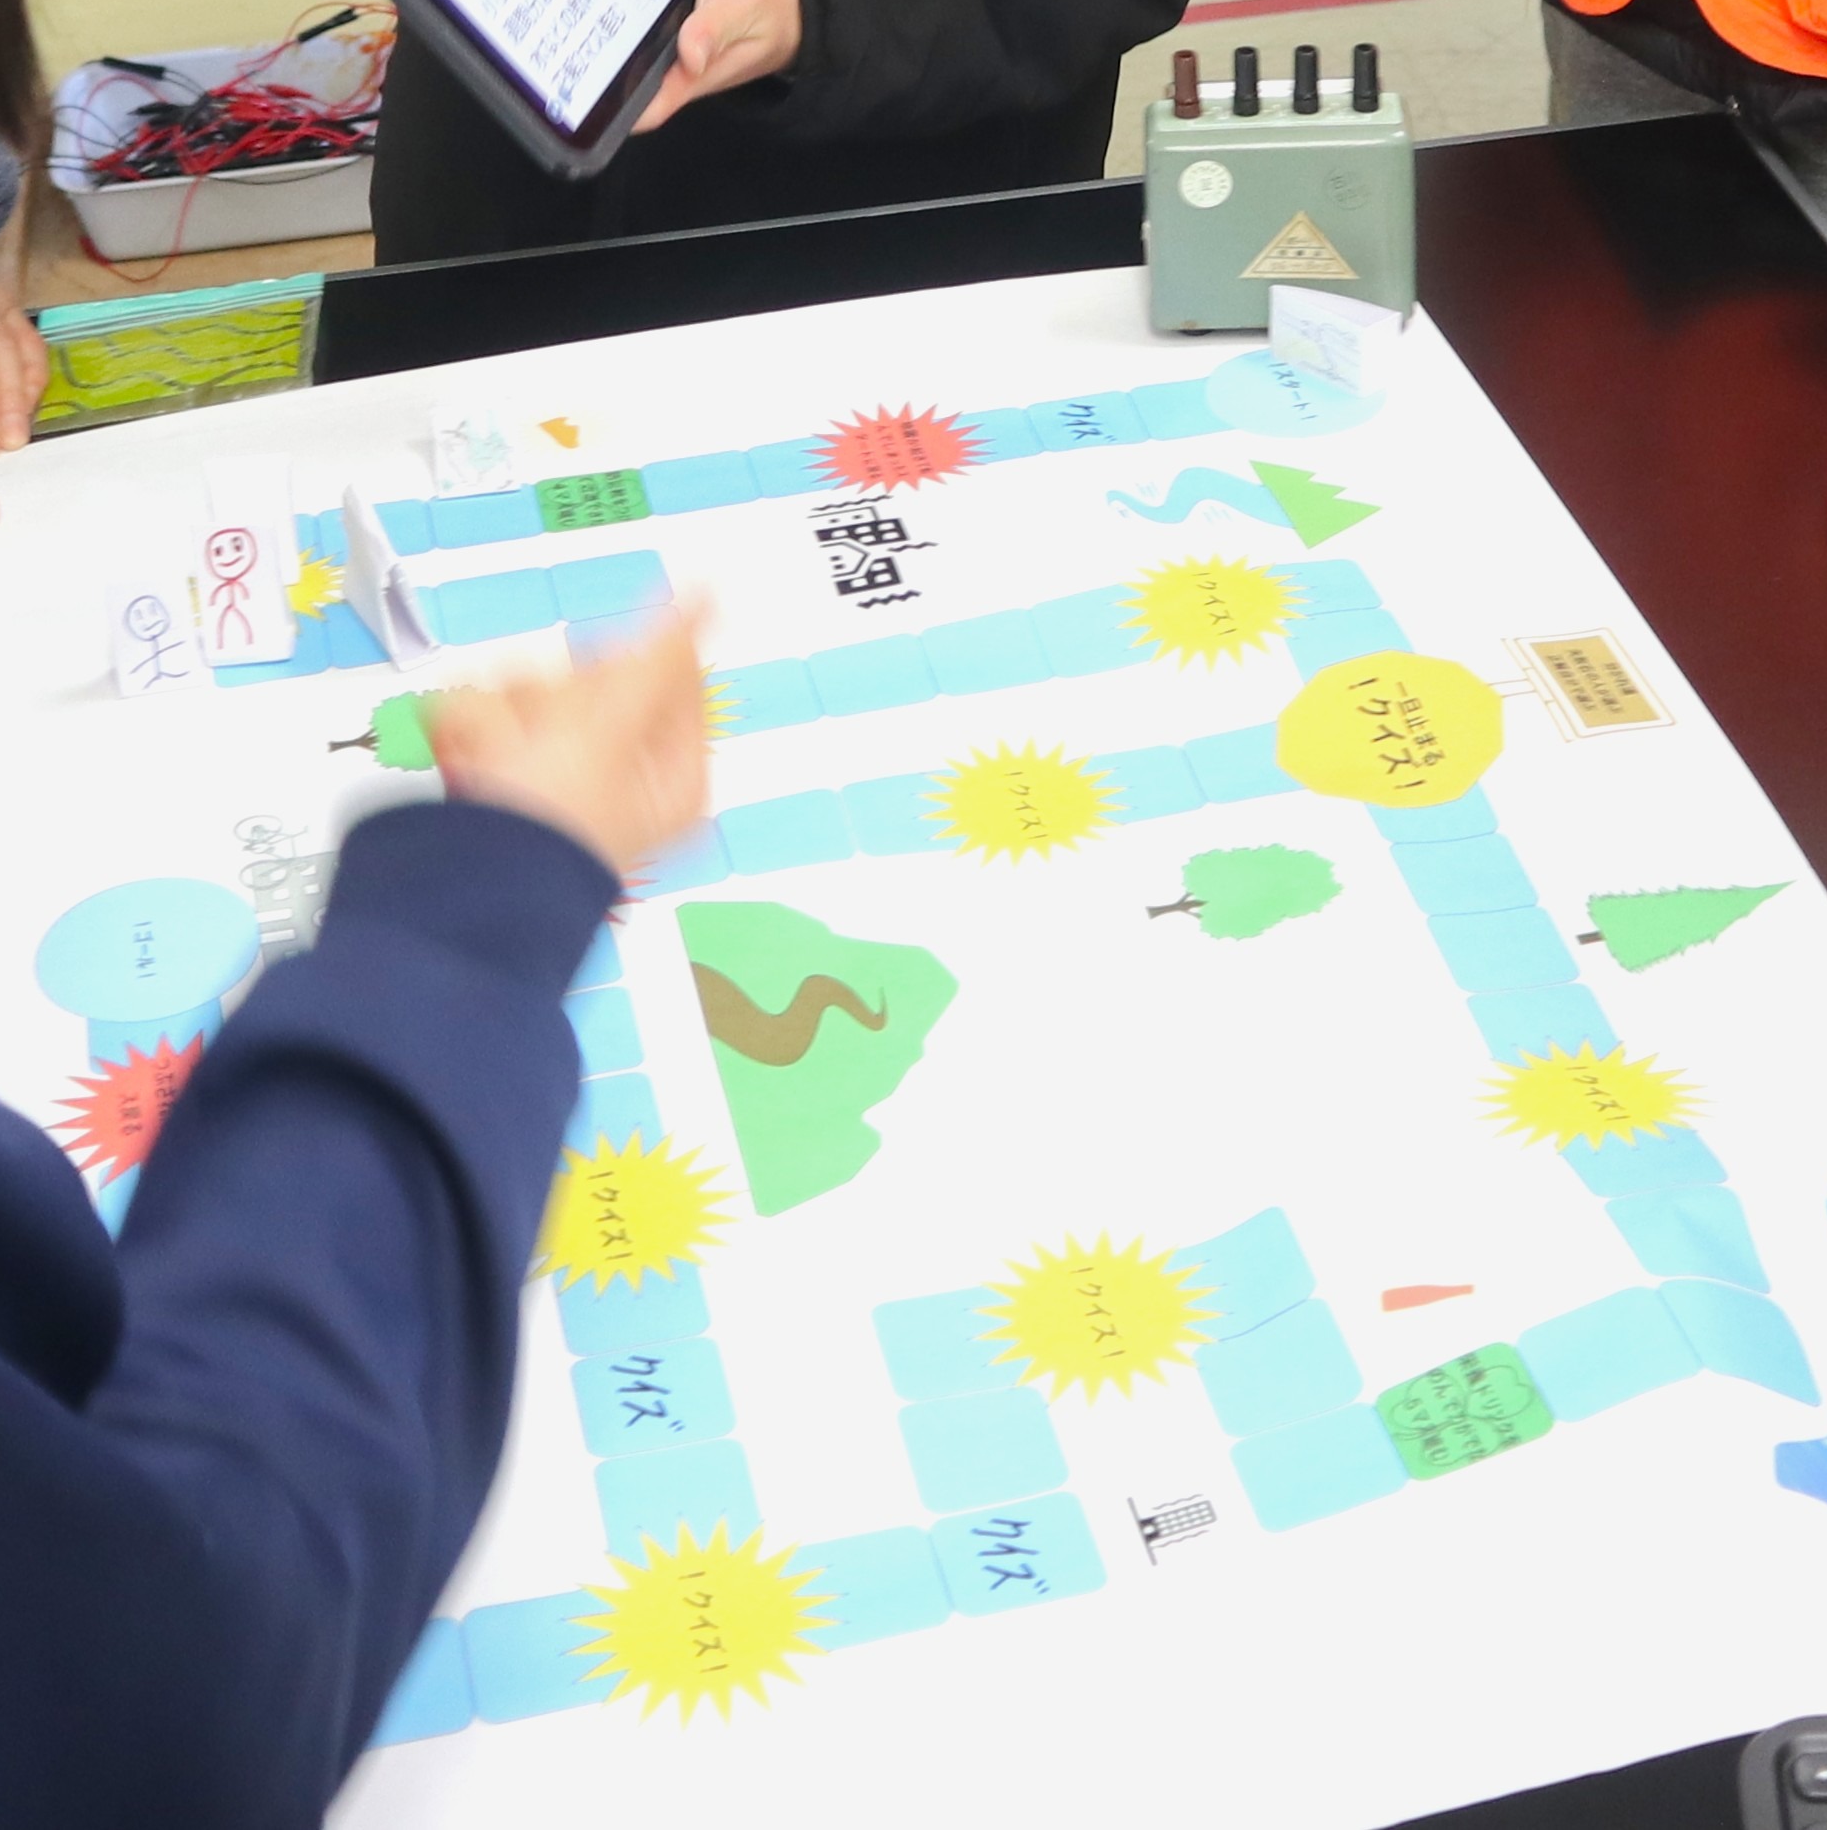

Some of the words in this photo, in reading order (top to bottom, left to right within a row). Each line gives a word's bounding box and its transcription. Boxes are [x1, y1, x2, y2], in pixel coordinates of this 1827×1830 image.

[1058, 403, 1118, 442] クイズ
[1397, 681, 1445, 767] 一旦止まる
[609, 1355, 686, 1433] クイズ
[971, 1517, 1050, 1595] クイズ
